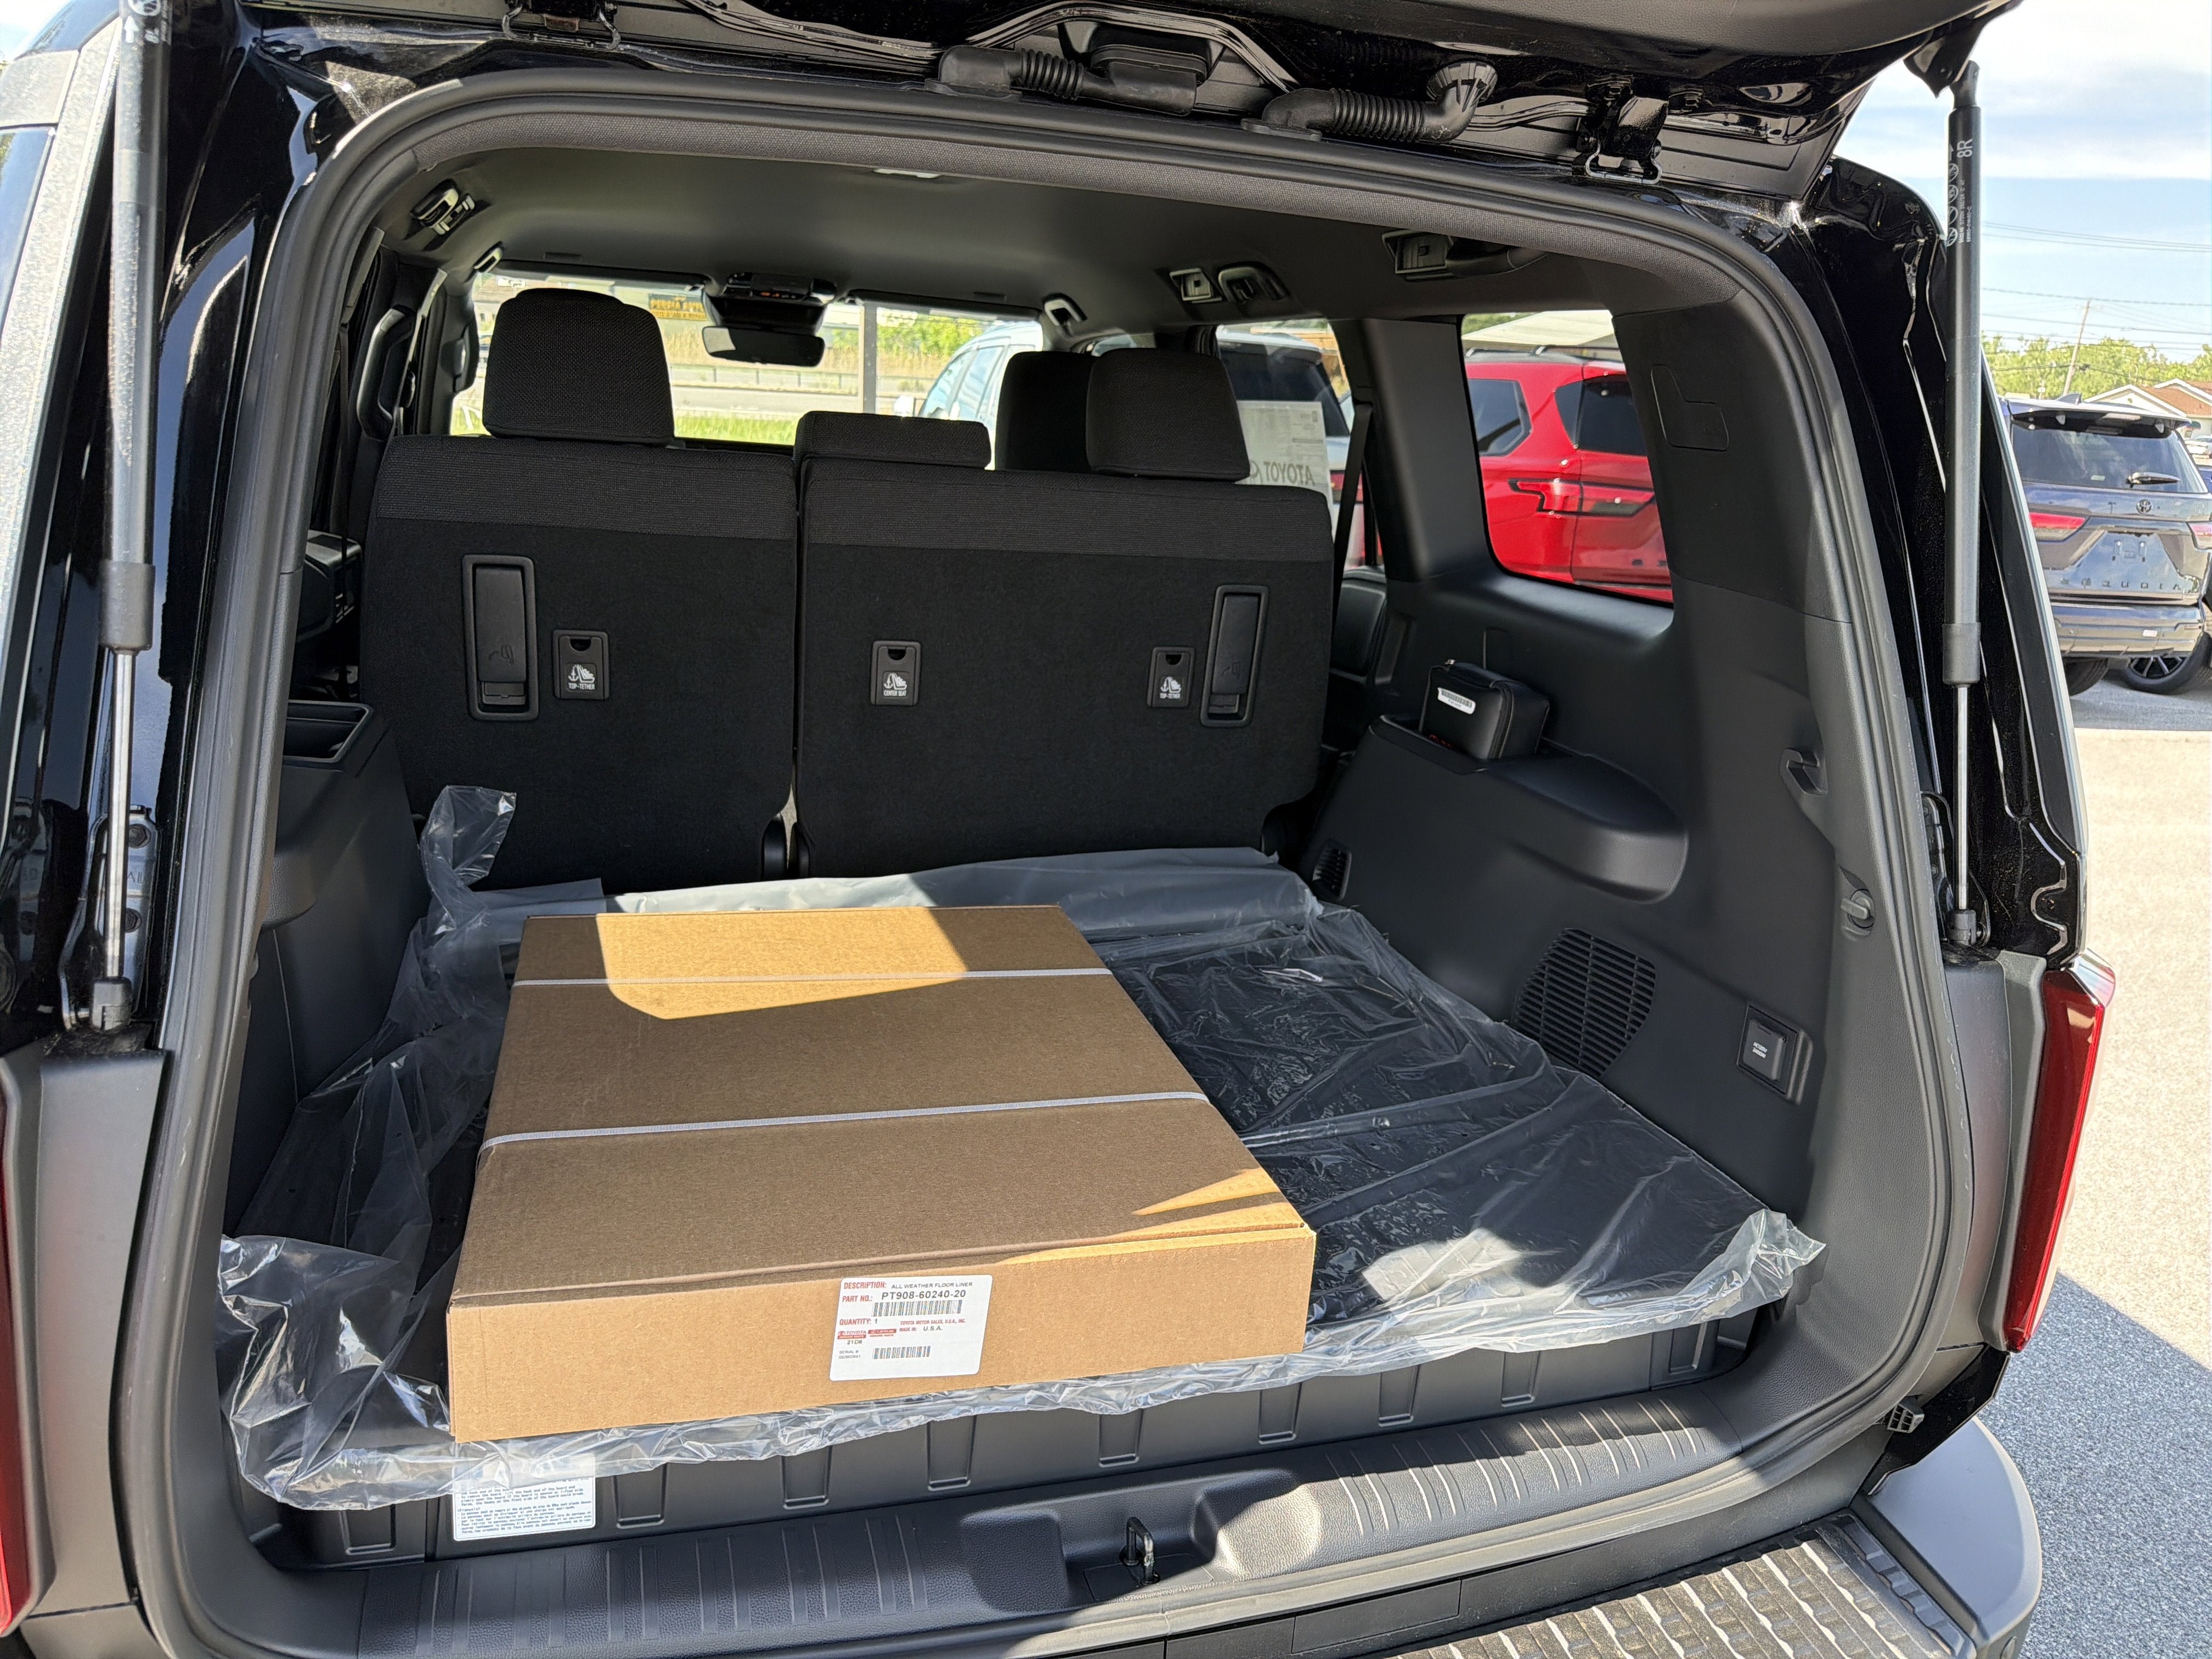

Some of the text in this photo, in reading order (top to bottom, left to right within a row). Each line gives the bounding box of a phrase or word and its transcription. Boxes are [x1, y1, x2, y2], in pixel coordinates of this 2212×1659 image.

[1957, 138, 1973, 157] 8R
[1263, 461, 1315, 486] TOYOTA
[882, 1290, 966, 1300] PT908-60240-20
